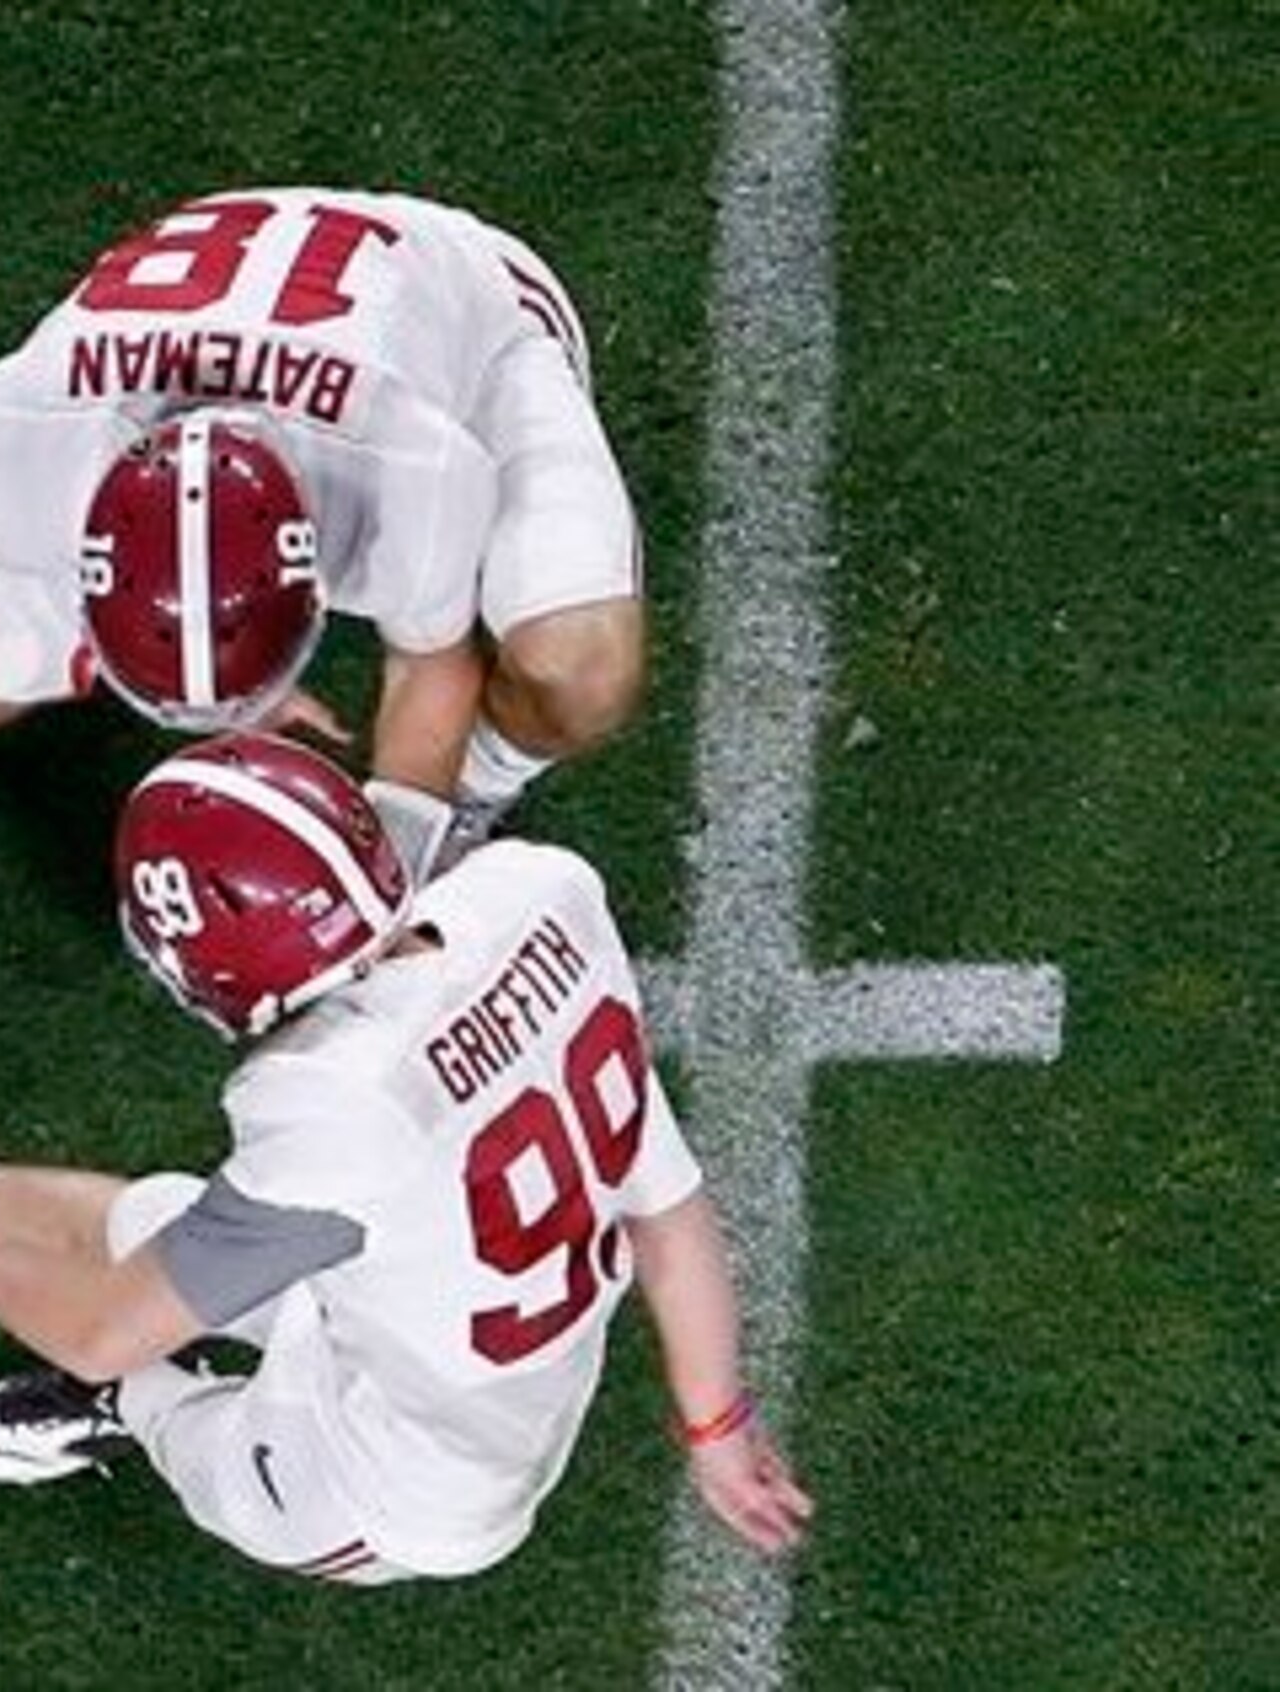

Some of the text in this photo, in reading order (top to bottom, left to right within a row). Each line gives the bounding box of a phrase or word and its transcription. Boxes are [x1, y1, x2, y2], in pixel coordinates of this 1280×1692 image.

[76, 200, 401, 327] 18
[68, 331, 357, 423] BATEMAN
[81, 533, 115, 596] 18
[276, 520, 317, 588] 18
[133, 858, 204, 938] 99
[426, 915, 588, 1104] GRIFFITH
[461, 995, 649, 1367] 99
